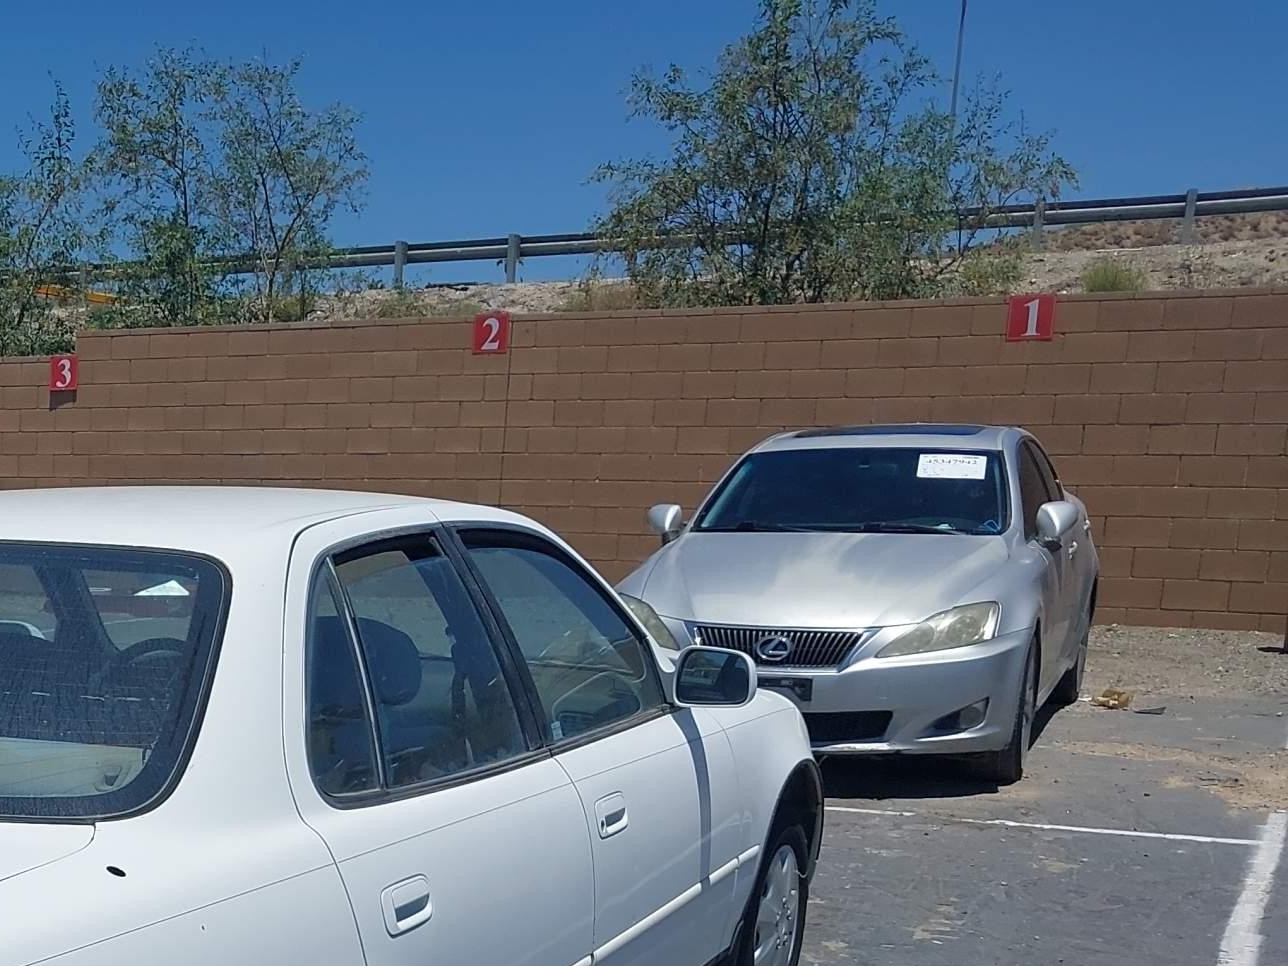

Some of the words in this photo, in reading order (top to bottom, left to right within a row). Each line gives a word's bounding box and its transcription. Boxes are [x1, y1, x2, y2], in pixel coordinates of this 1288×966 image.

[481, 316, 501, 351] 2
[1021, 298, 1042, 337] 1
[55, 358, 72, 388] 3
